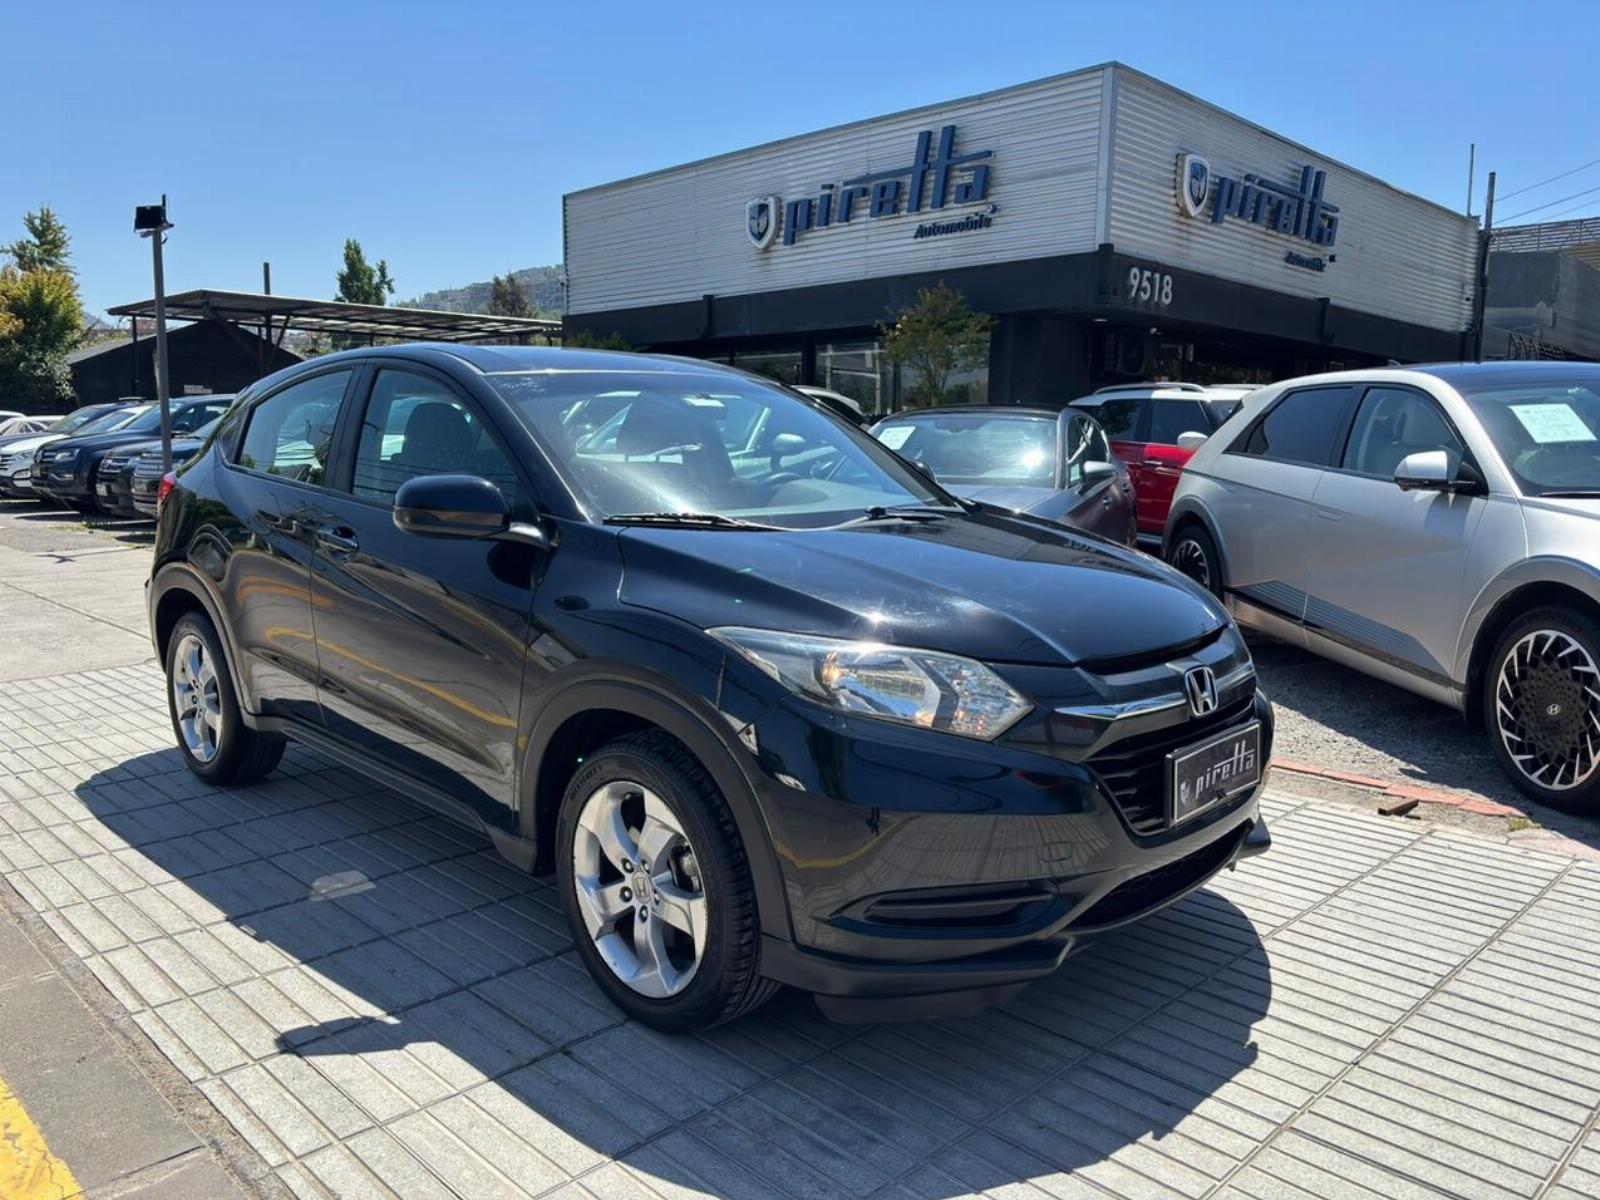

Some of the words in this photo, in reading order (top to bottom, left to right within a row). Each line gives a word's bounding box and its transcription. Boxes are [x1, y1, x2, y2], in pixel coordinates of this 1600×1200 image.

[783, 124, 992, 246] piretta
[1211, 165, 1339, 247] piretta
[1129, 267, 1173, 305] 9518
[1195, 740, 1255, 800] piretta
